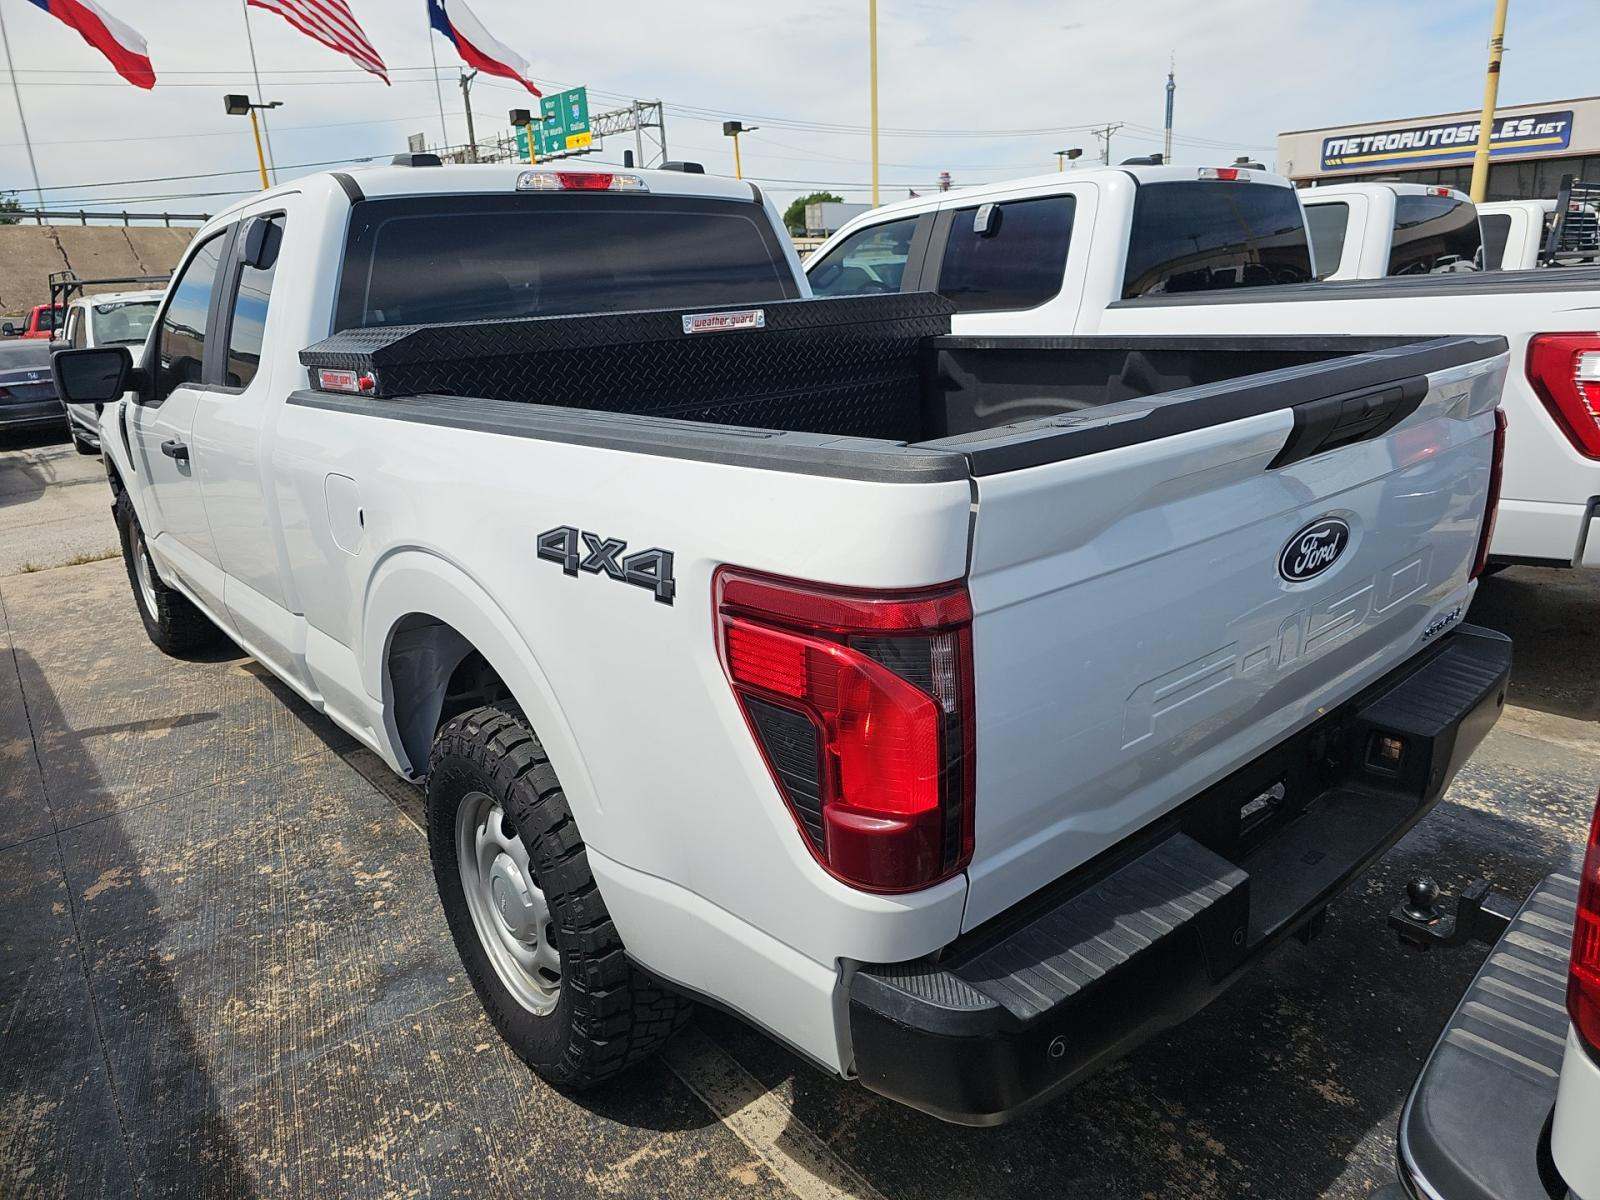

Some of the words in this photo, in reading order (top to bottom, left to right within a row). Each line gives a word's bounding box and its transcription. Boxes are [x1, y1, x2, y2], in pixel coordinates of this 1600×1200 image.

[694, 315, 729, 328] weather
[731, 313, 754, 327] guard
[1294, 527, 1341, 575] Ford
